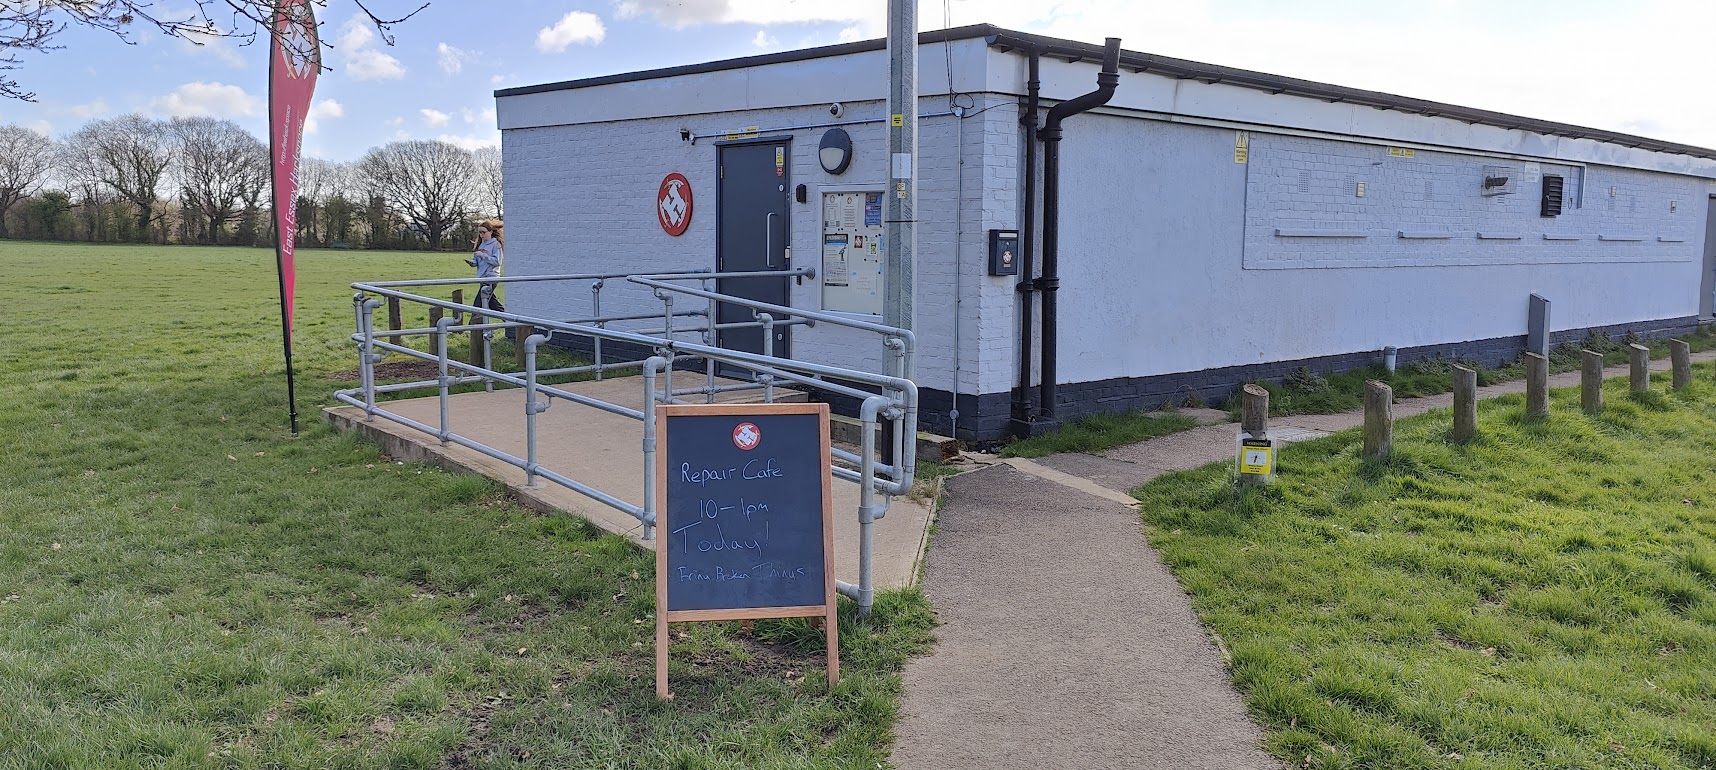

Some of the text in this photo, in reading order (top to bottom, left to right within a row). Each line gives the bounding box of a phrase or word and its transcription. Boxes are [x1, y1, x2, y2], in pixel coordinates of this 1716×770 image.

[285, 187, 298, 225] Essex
[282, 225, 294, 256] East
[681, 457, 783, 487] Repair Cafe
[673, 520, 770, 562] Today!
